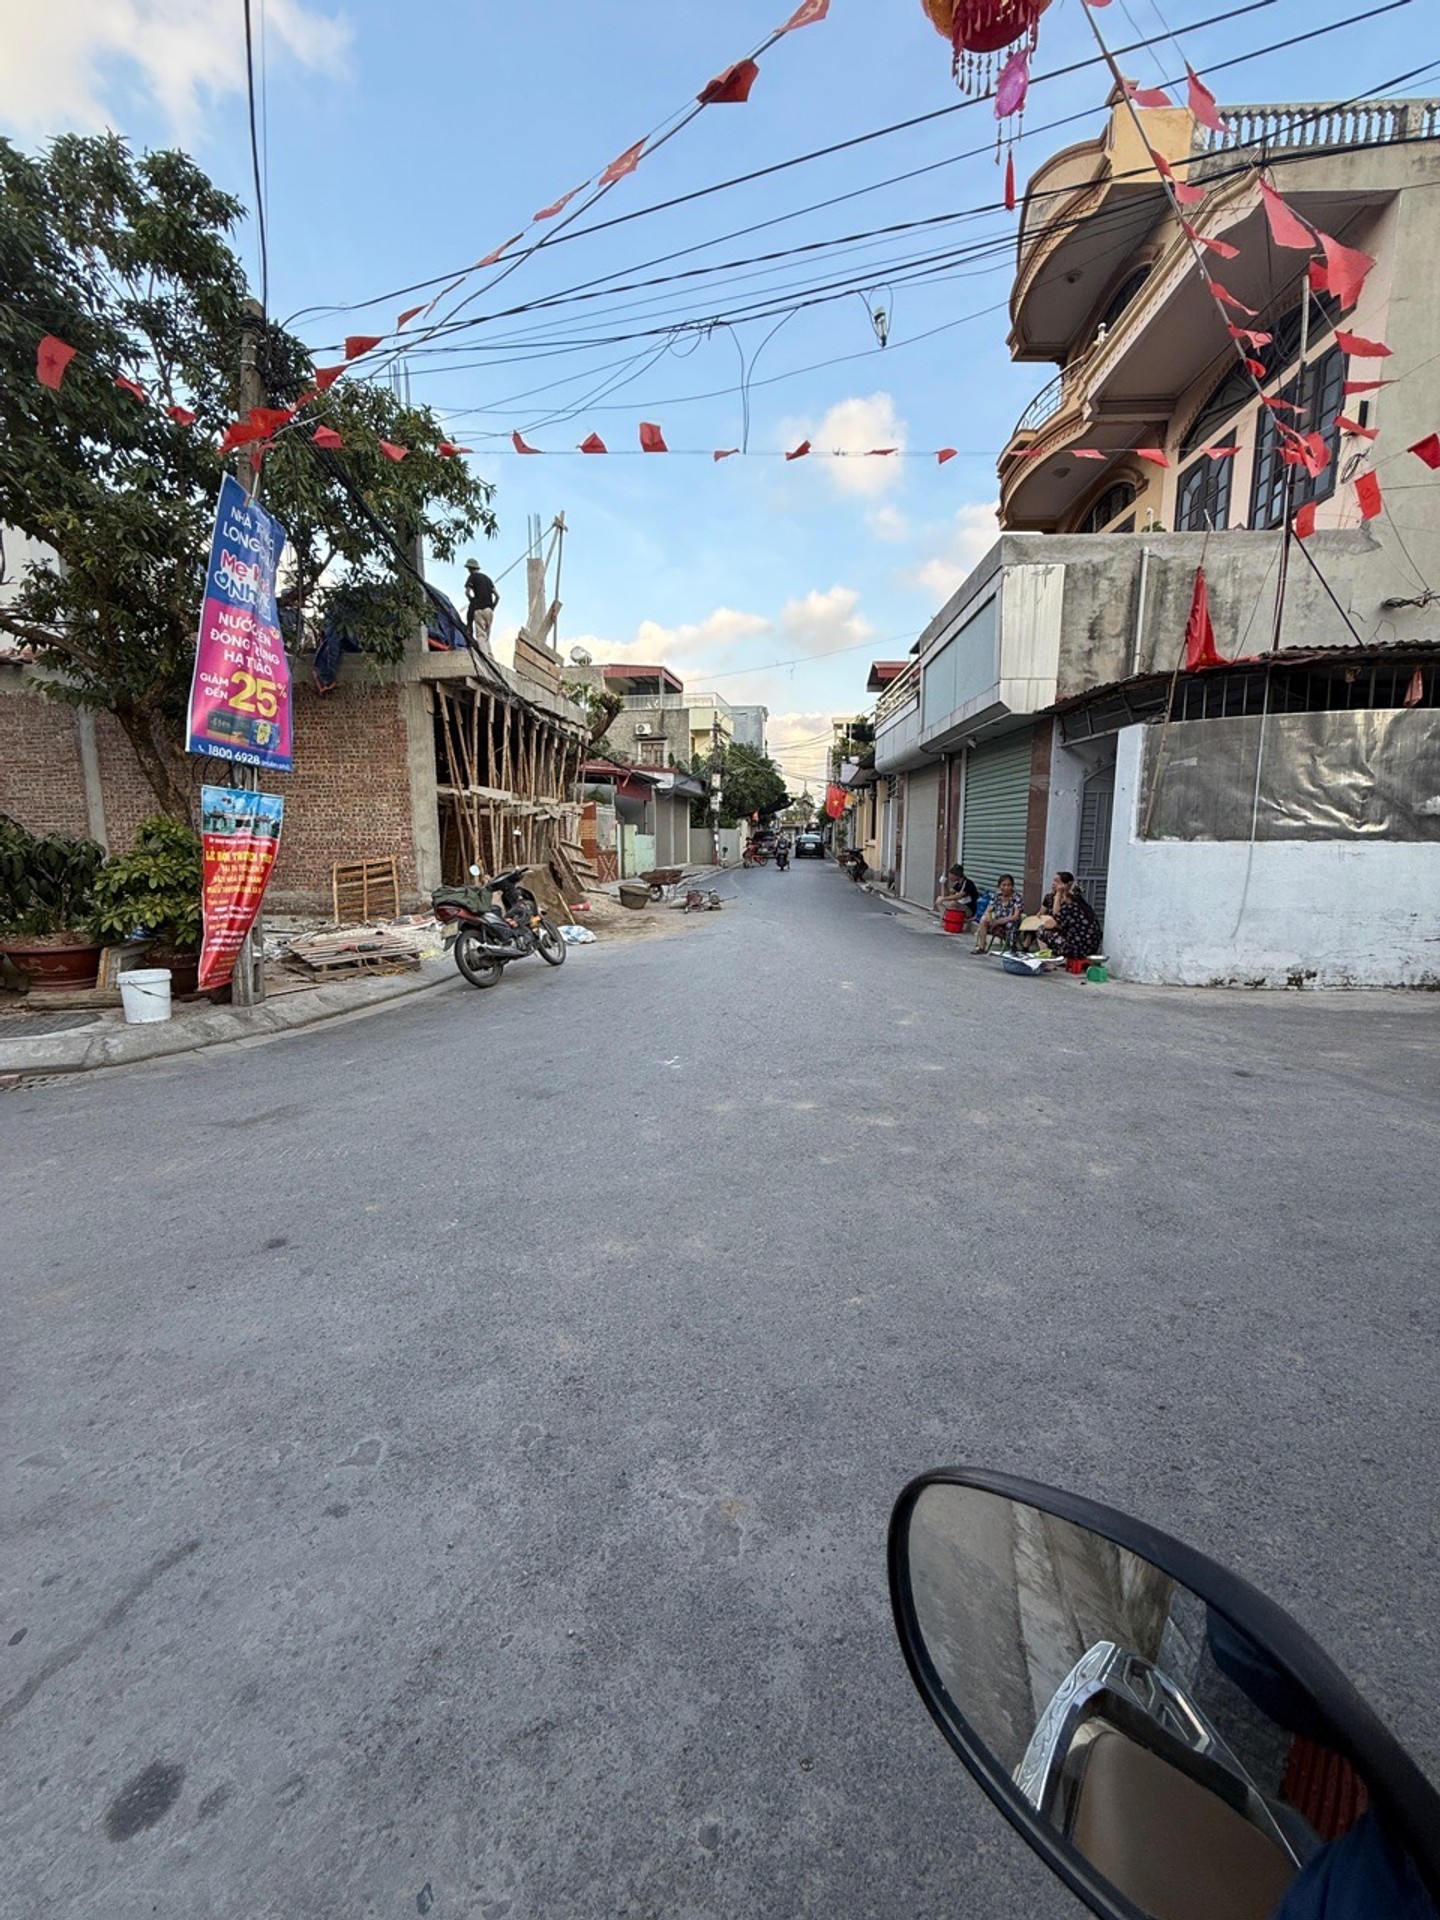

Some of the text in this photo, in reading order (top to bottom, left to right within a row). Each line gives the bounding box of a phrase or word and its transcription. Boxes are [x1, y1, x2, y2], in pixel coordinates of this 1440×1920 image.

[231, 506, 252, 529] NHÀ
[223, 521, 262, 552] LONG
[221, 549, 249, 582] Mẹ
[210, 628, 251, 650] ĐÔNG
[224, 650, 244, 668] HẠ
[200, 673, 229, 687] GIẢM
[204, 685, 228, 699] ĐẾN
[208, 744, 233, 761] 1800
[234, 752, 261, 766] 6928
